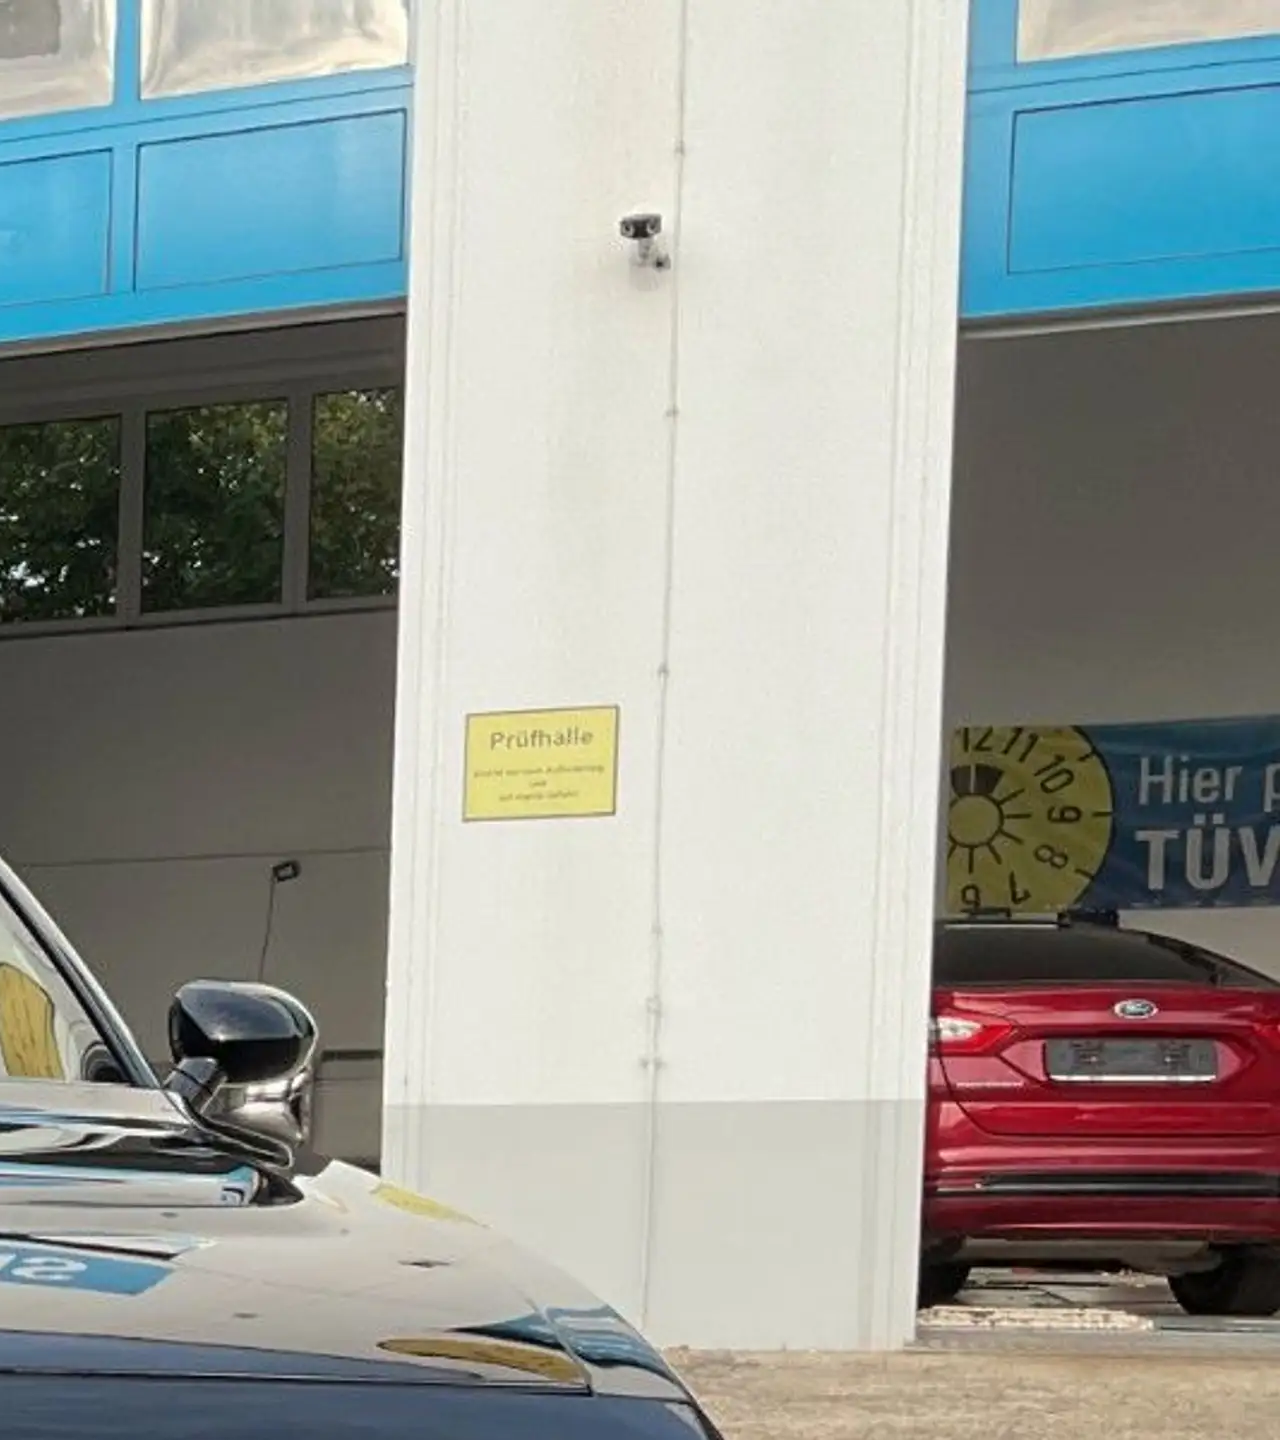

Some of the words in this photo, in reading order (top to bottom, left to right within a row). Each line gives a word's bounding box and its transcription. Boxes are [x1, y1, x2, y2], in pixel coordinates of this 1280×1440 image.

[489, 726, 595, 751] Prüfhalle
[1034, 754, 1075, 794] 10
[1138, 754, 1243, 805] Hier
[1046, 805, 1082, 824] 9
[1034, 844, 1069, 870] 8
[1135, 812, 1280, 891] TÜV
